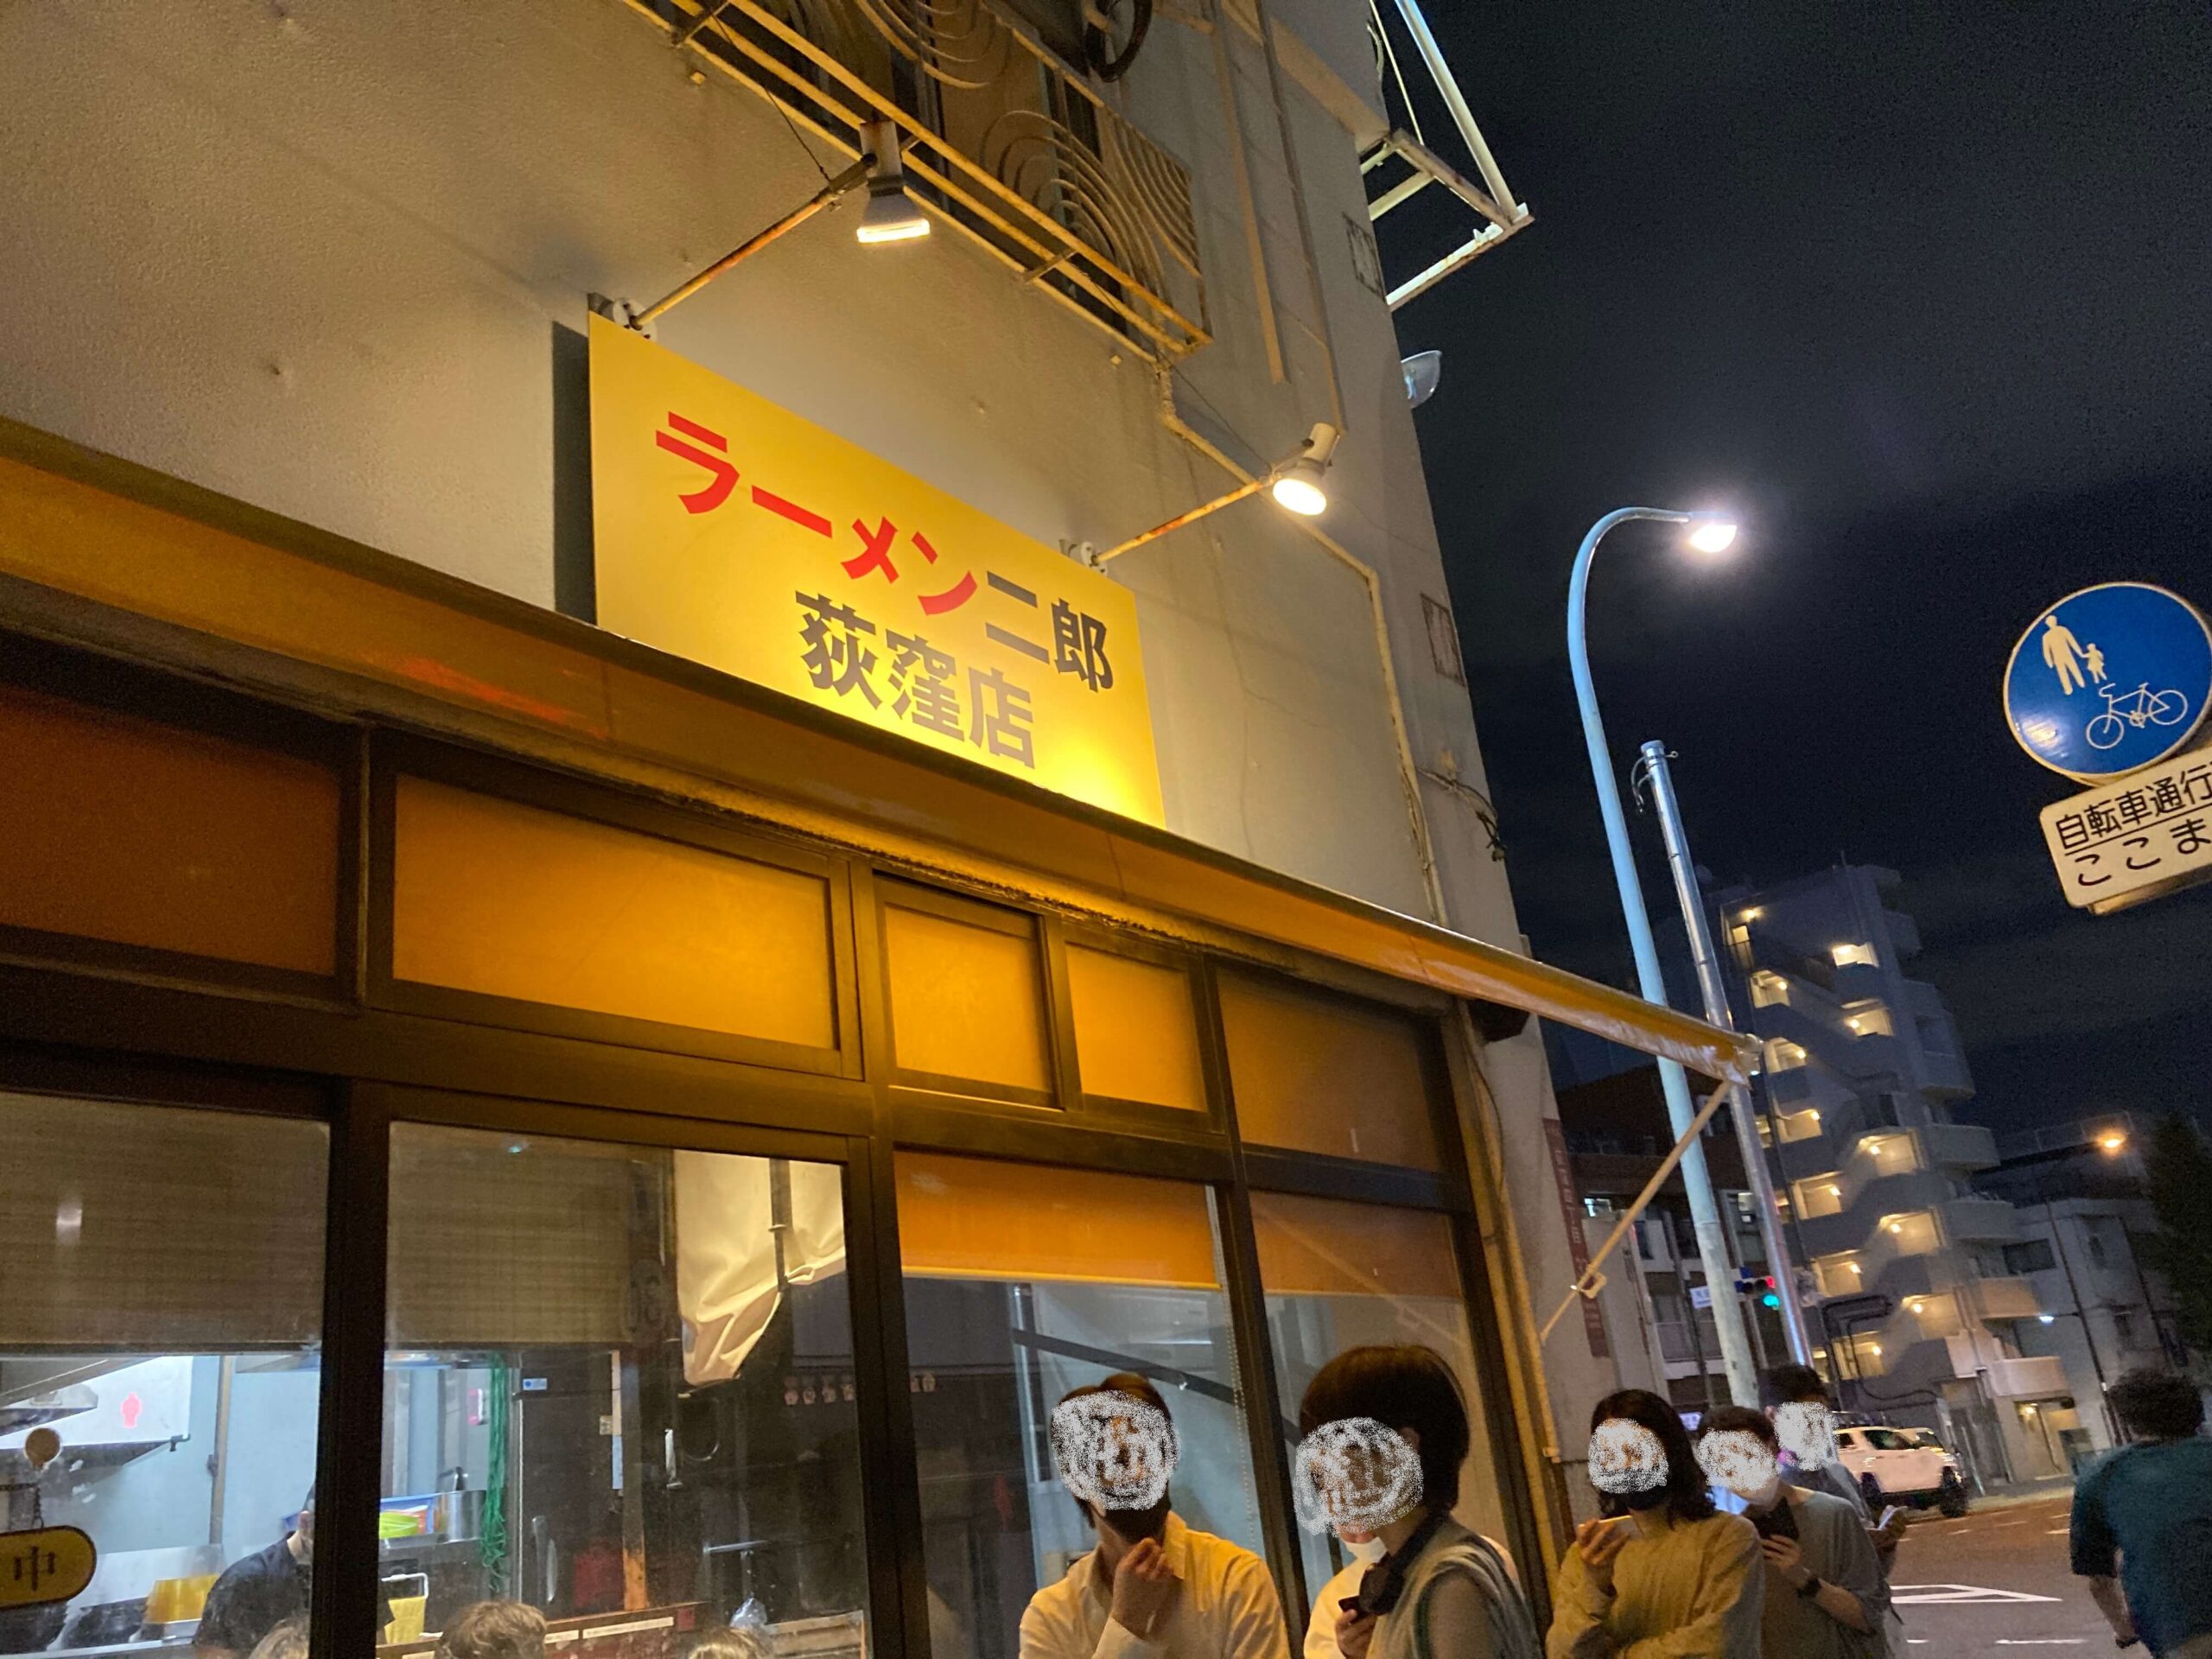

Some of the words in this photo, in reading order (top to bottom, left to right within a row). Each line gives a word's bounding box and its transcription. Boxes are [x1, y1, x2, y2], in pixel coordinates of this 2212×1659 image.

[655, 410, 1114, 693] ラーメン二郎
[794, 589, 1036, 770] 荻窪店
[2055, 761, 2212, 850] 自転車通行
[2074, 818, 2212, 887] ここま
